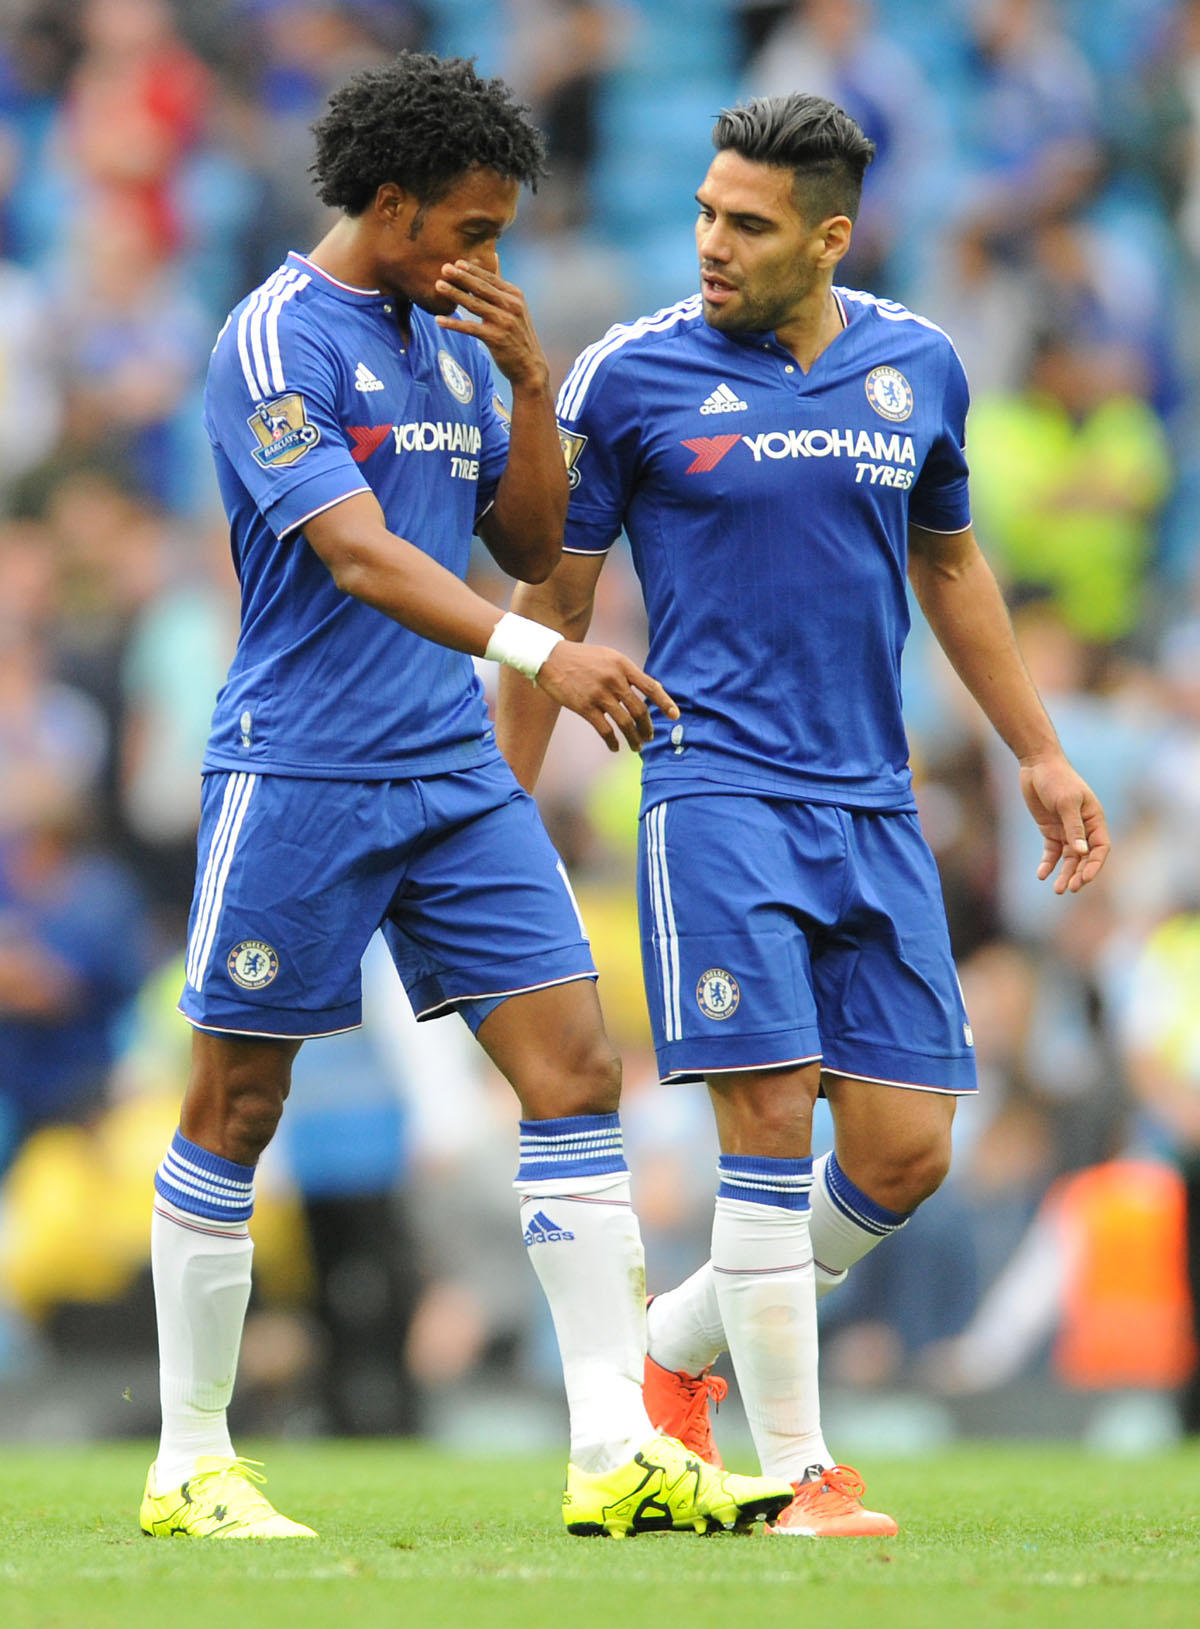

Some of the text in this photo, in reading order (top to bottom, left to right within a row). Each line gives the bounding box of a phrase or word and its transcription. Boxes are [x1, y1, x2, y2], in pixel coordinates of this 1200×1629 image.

[699, 401, 748, 415] adidas
[391, 421, 482, 455] YOKOHAMA
[742, 429, 916, 466] YOKOHAMA
[450, 457, 480, 480] TYRE
[855, 463, 914, 490] TYRES
[240, 941, 273, 957] CHELSEA
[522, 1231, 575, 1247] didas
